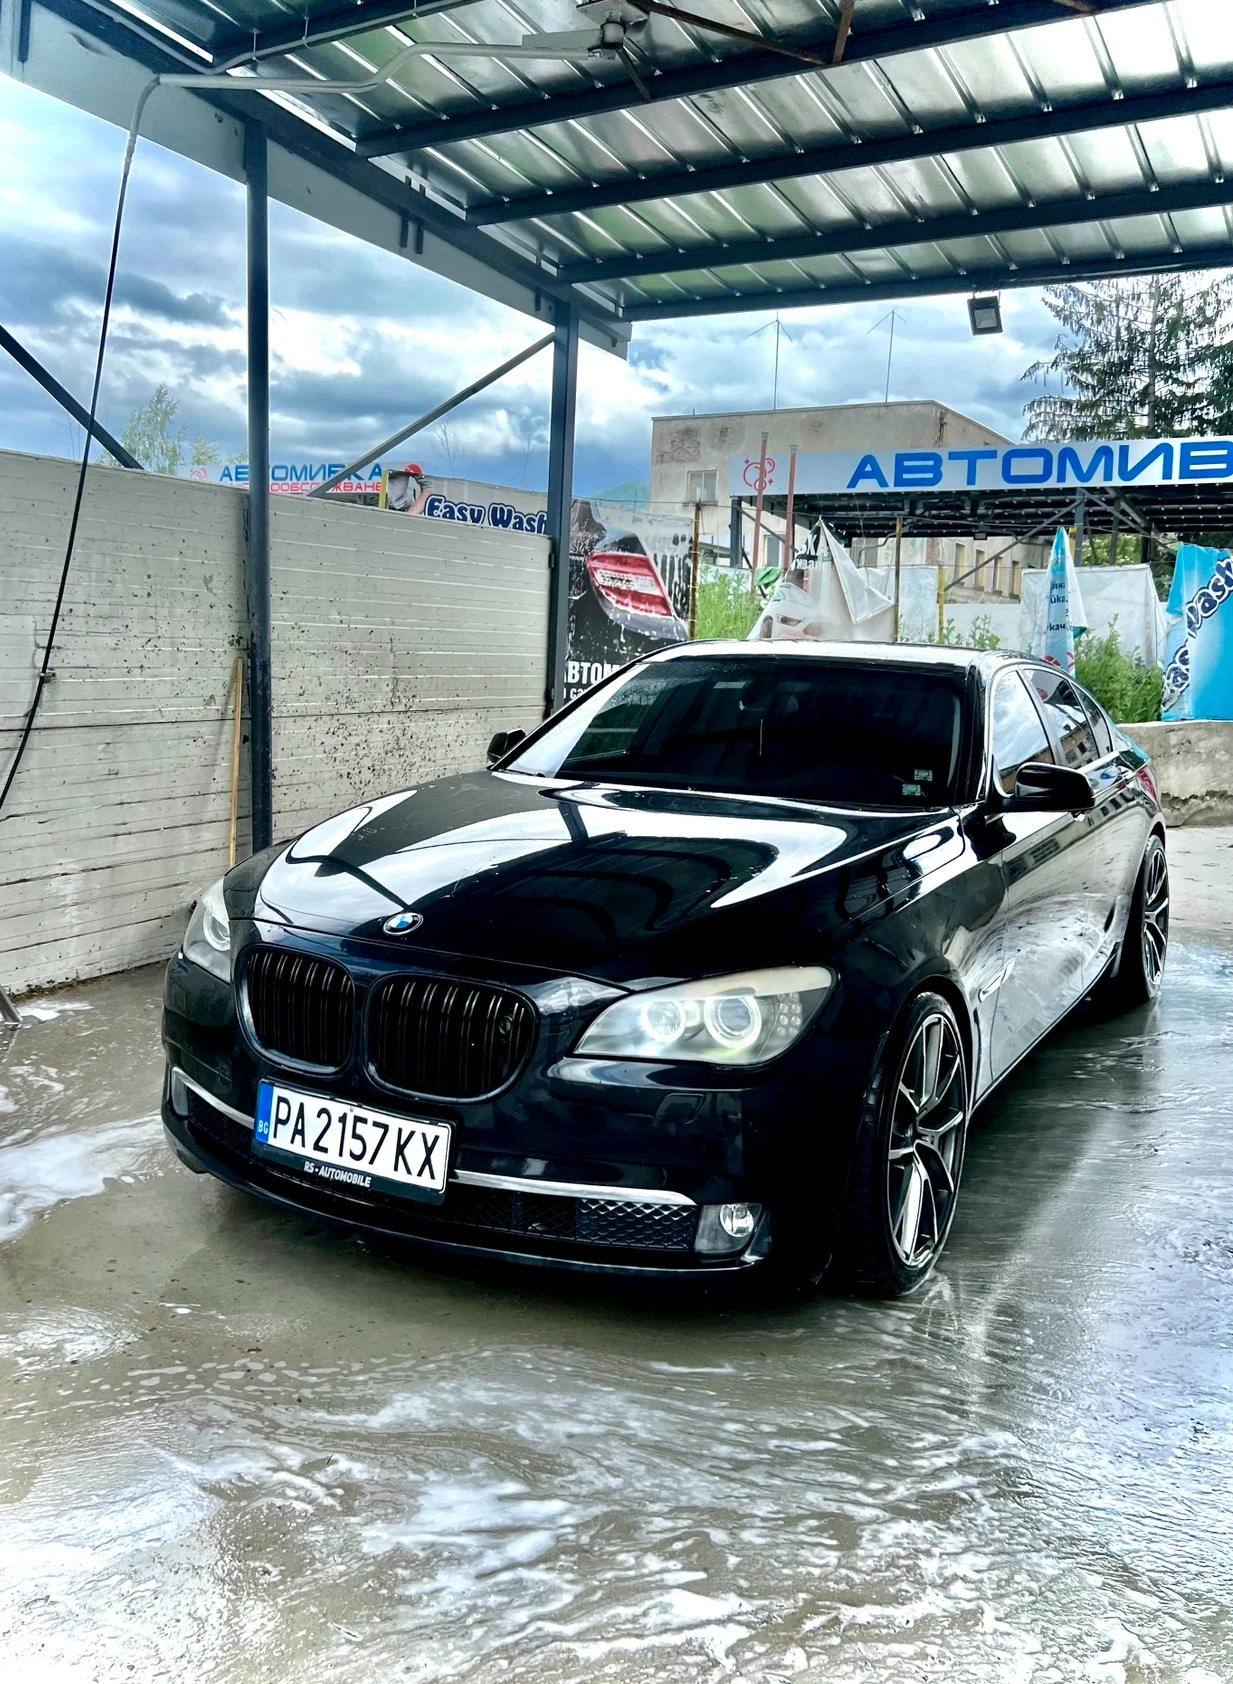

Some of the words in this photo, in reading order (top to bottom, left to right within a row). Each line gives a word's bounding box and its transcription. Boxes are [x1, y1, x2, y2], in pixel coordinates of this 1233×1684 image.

[846, 440, 1233, 489] АВТОМИВ
[424, 494, 486, 526] Easy
[258, 1119, 269, 1135] BG
[273, 1095, 306, 1148] PA
[313, 1107, 390, 1165] 2157
[394, 1127, 440, 1180] KX
[319, 1165, 372, 1187] AUTOMOBILE
